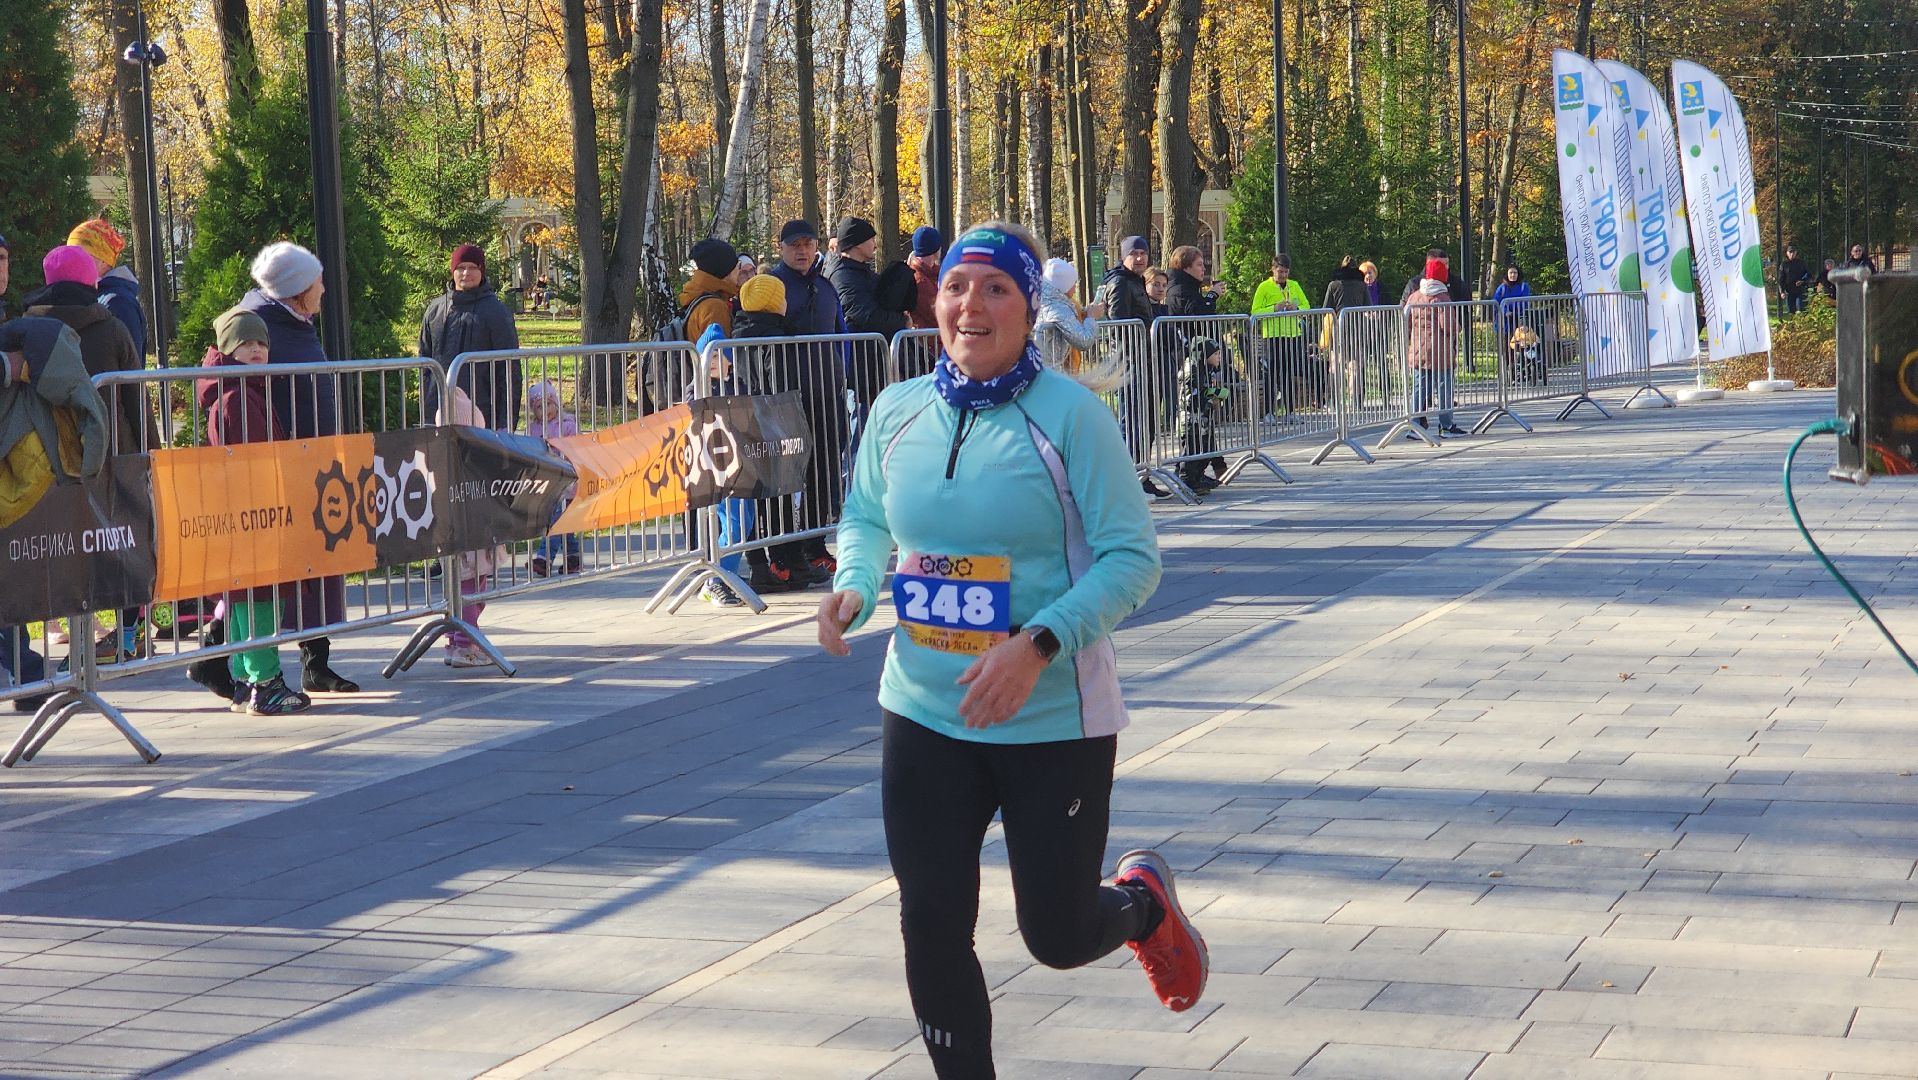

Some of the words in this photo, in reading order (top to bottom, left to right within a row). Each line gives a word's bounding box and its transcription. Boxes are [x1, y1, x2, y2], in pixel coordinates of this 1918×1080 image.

[780, 437, 804, 456] СПОРТА
[448, 480, 487, 504] ФАБРИКА
[489, 478, 550, 497] СПОРТА
[181, 516, 237, 539] ФАБРИКА
[240, 505, 294, 531] СПОРТА
[10, 532, 76, 562] ФАБРИКА
[83, 525, 136, 553] СПОРТА
[902, 580, 995, 626] 248
